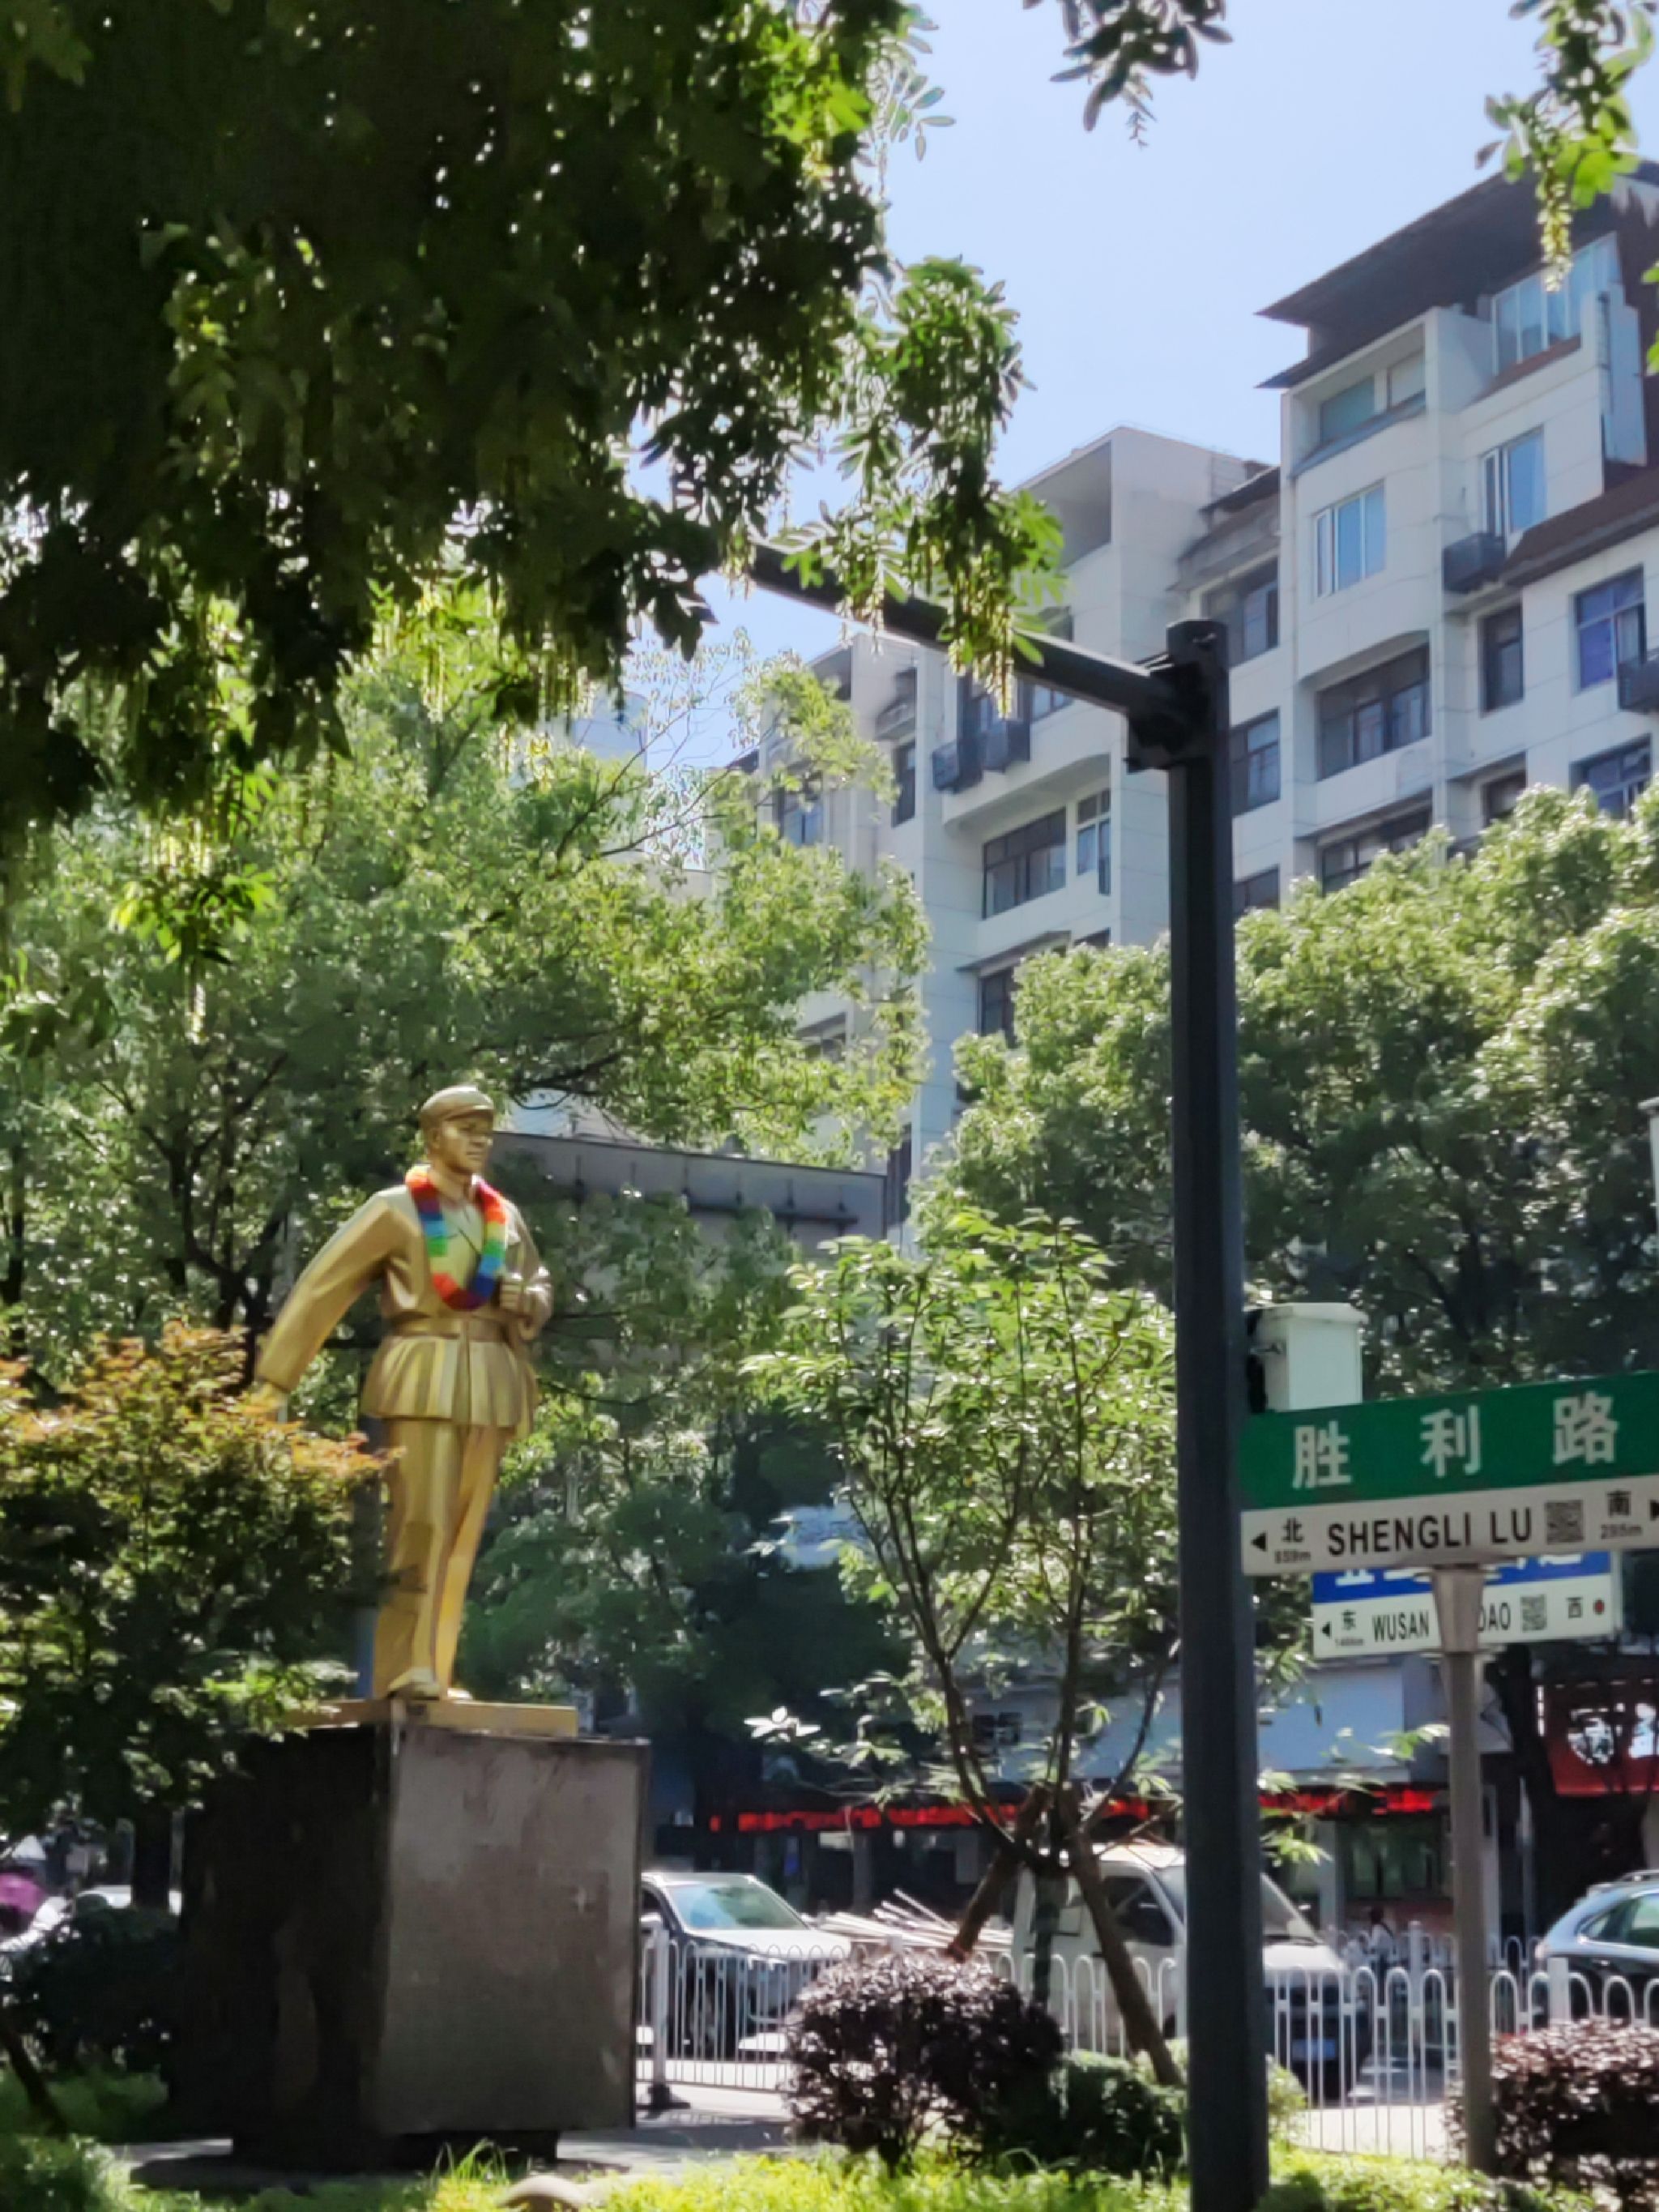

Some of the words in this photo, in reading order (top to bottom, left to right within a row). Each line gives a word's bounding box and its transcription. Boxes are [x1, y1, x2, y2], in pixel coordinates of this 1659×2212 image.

[1292, 1391, 1619, 1488] 胜利路
[1282, 1517, 1303, 1544] 北
[1328, 1512, 1471, 1557] SHENGLI
[1490, 1507, 1533, 1544] LU
[1371, 1609, 1430, 1642] WUSAN
[1478, 1601, 1512, 1633] DAO
